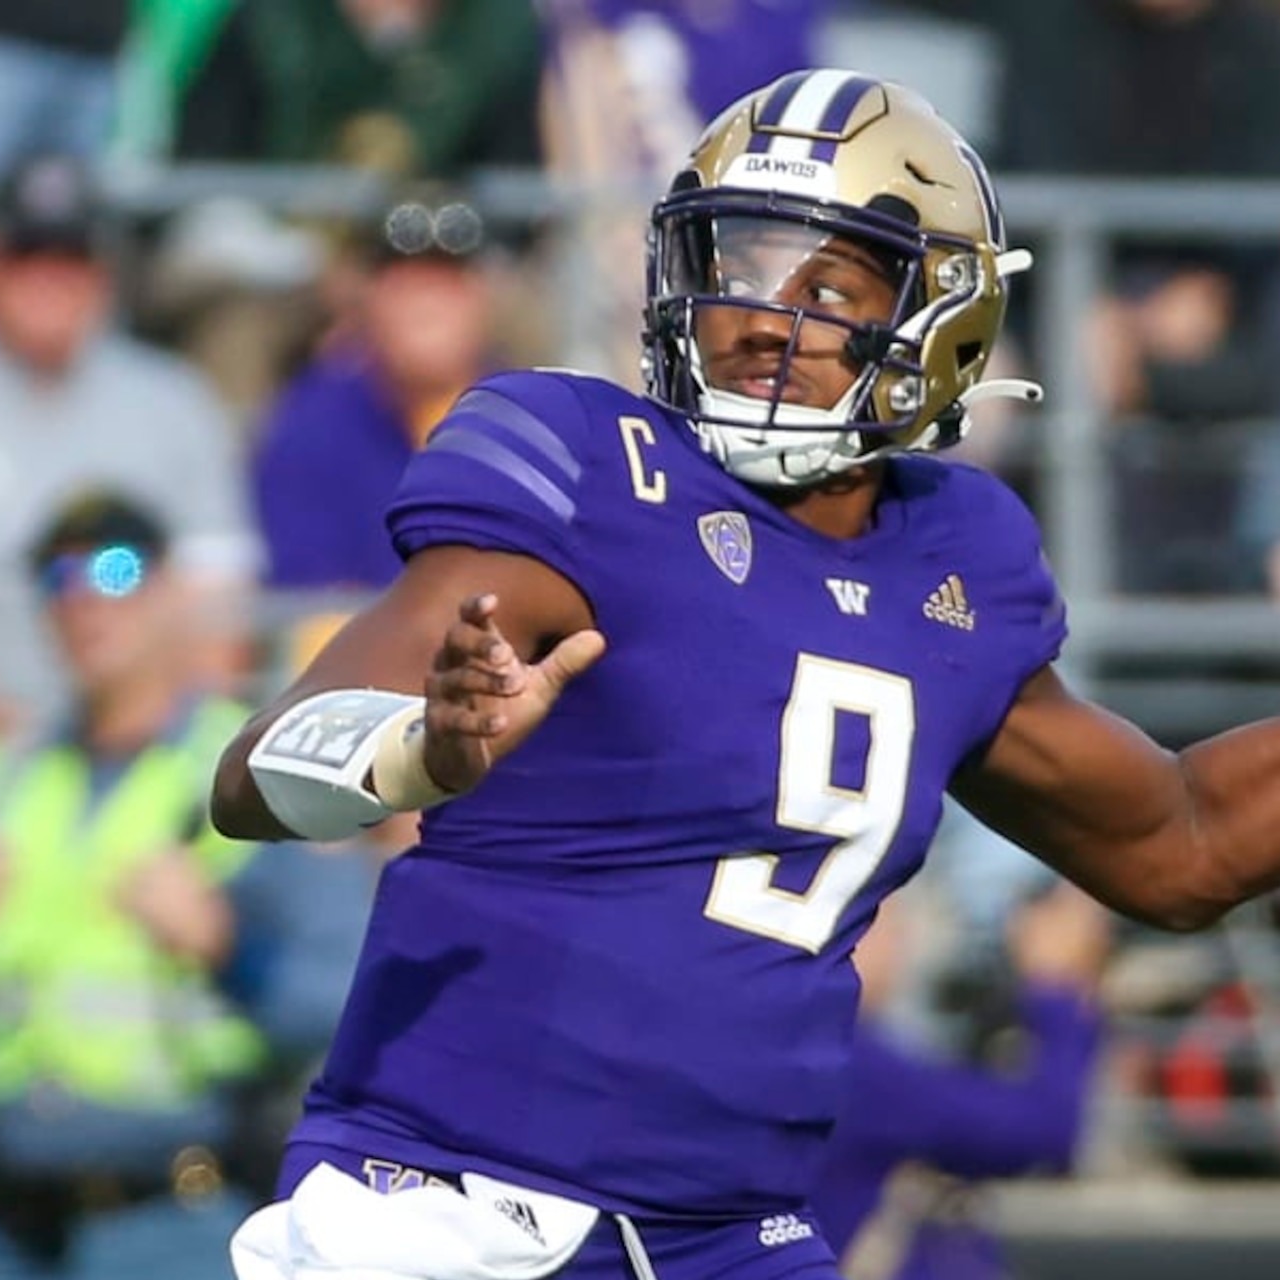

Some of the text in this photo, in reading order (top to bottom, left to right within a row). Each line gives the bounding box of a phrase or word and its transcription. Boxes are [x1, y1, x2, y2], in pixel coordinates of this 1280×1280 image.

[618, 415, 666, 503] C
[825, 579, 870, 615] W
[703, 651, 916, 955] 9
